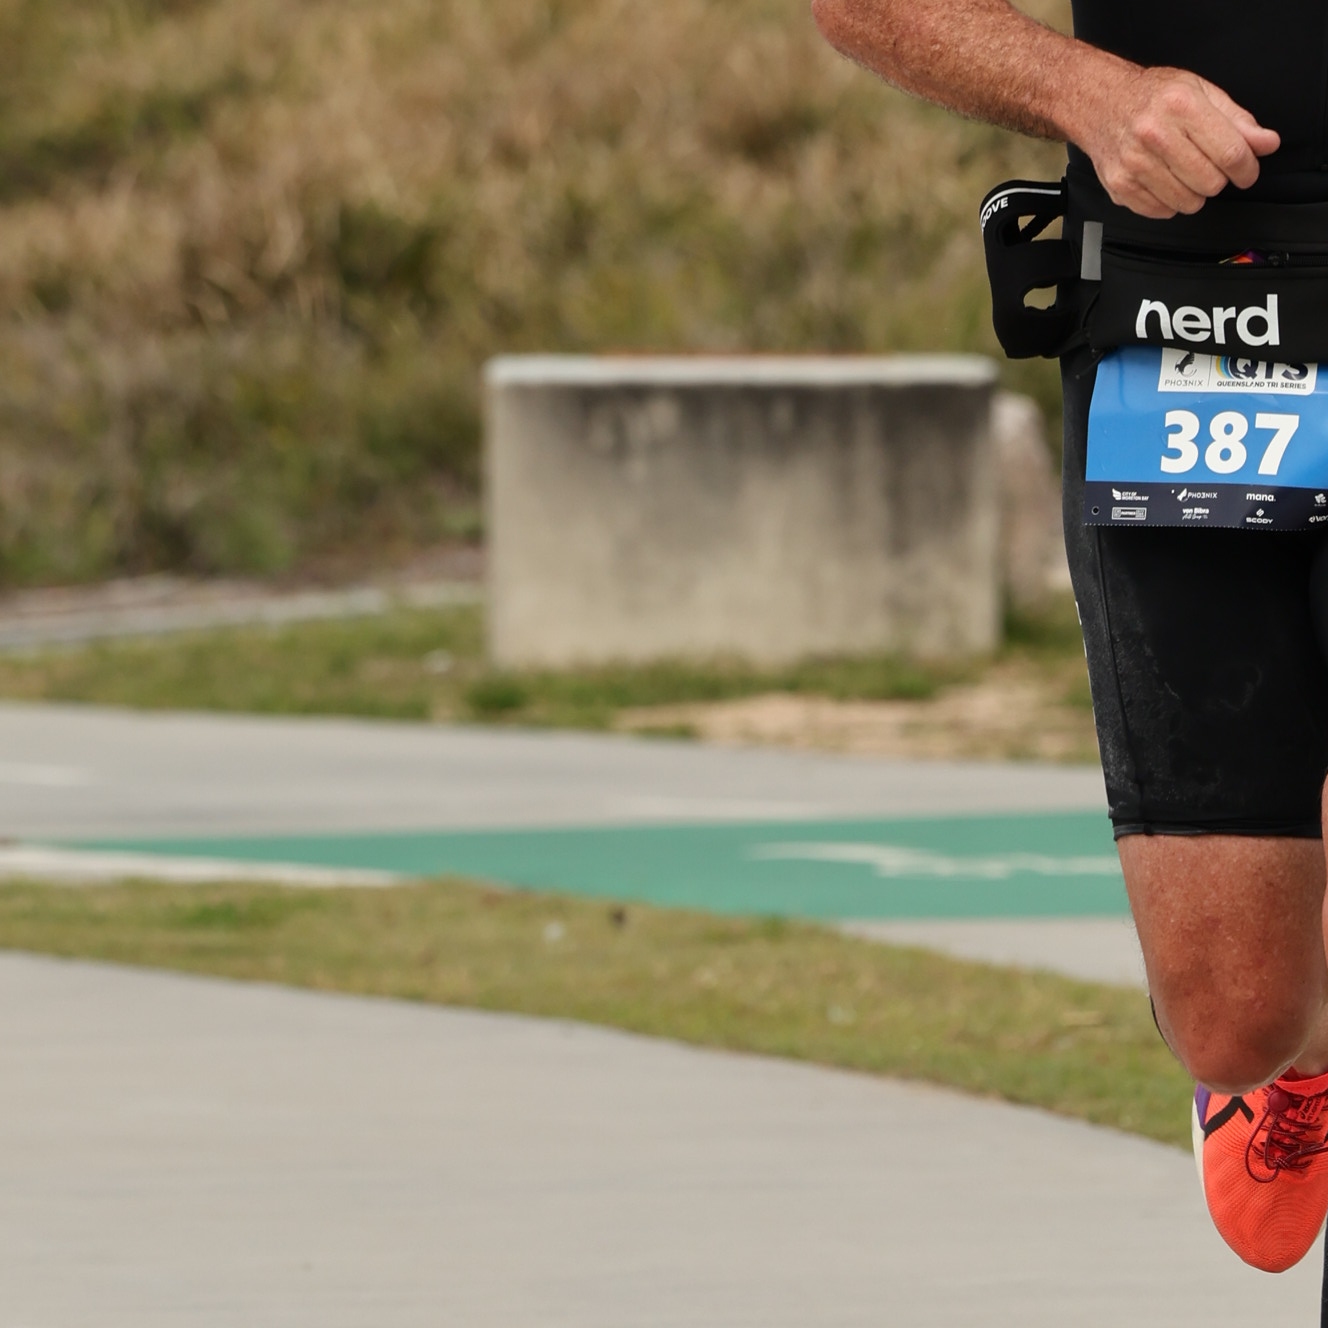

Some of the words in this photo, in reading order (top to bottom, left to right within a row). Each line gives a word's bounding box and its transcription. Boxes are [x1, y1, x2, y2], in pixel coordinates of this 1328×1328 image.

[981, 196, 1009, 230] OOVE
[1135, 293, 1280, 346] nerd
[1280, 382, 1307, 390] SERIES
[1160, 409, 1300, 476] 387
